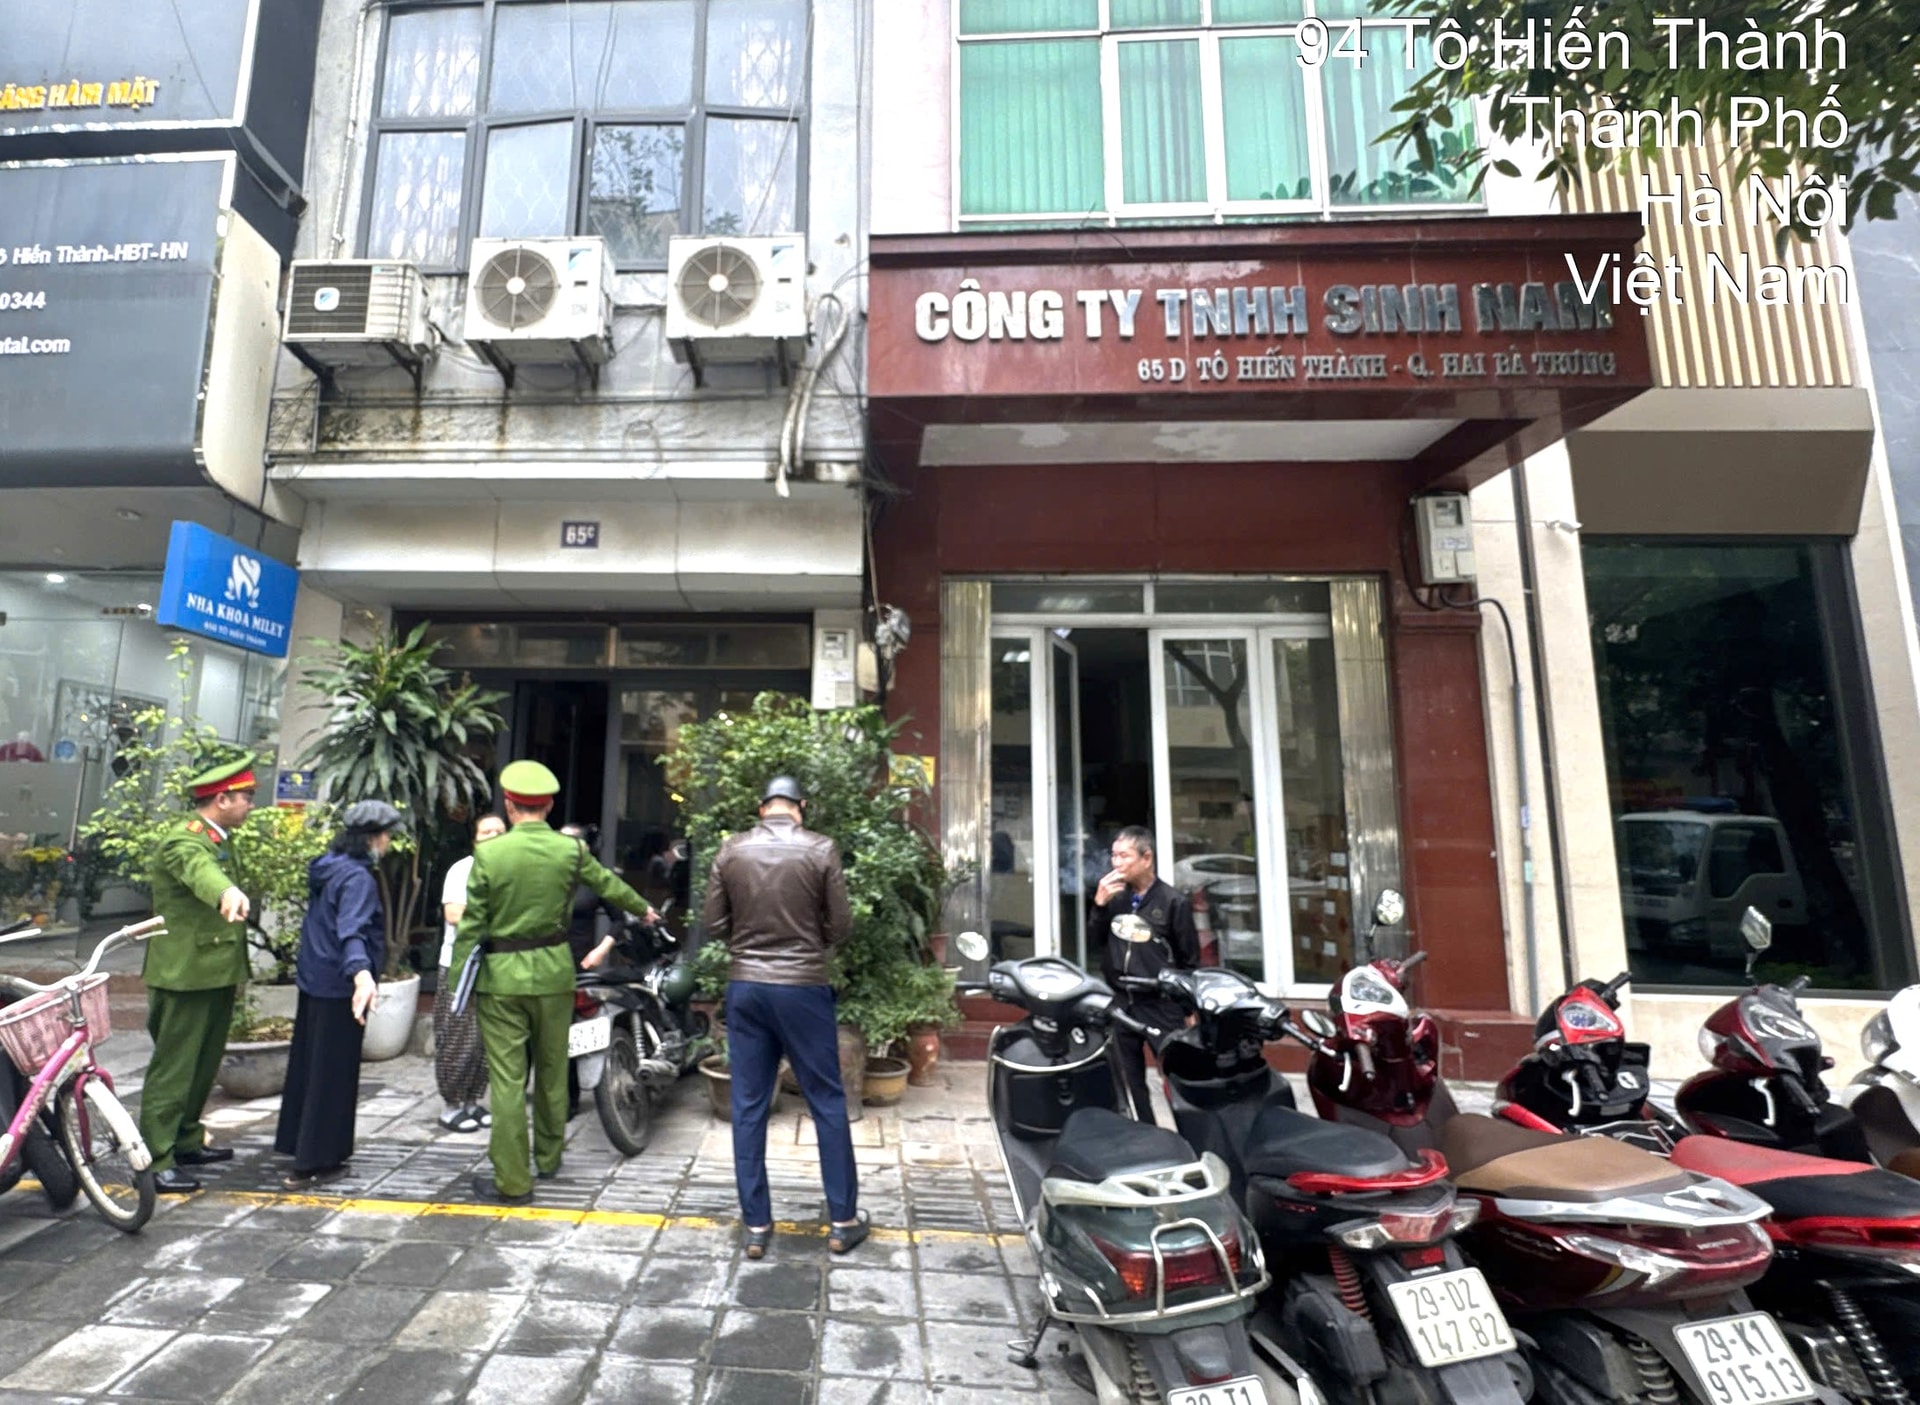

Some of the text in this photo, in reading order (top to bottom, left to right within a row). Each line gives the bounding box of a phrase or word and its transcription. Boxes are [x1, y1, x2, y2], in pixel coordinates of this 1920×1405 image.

[0, 82, 47, 109] ĂNG
[915, 278, 1614, 342] CÔNG TY TNHH SINH NAM
[1197, 349, 1229, 380] TÔ
[1237, 346, 1296, 380] HIẾN
[1303, 347, 1388, 380] THÀNH
[1440, 352, 1487, 377] HAI
[1492, 344, 1527, 376] BÀ
[186, 593, 213, 616] NHA
[217, 602, 249, 627] KHOA
[1406, 1277, 1481, 1321] 29-D2
[1417, 1312, 1508, 1359] 147.82
[1693, 1319, 1775, 1364] 29-K1
[1707, 1357, 1806, 1404] 915.13
